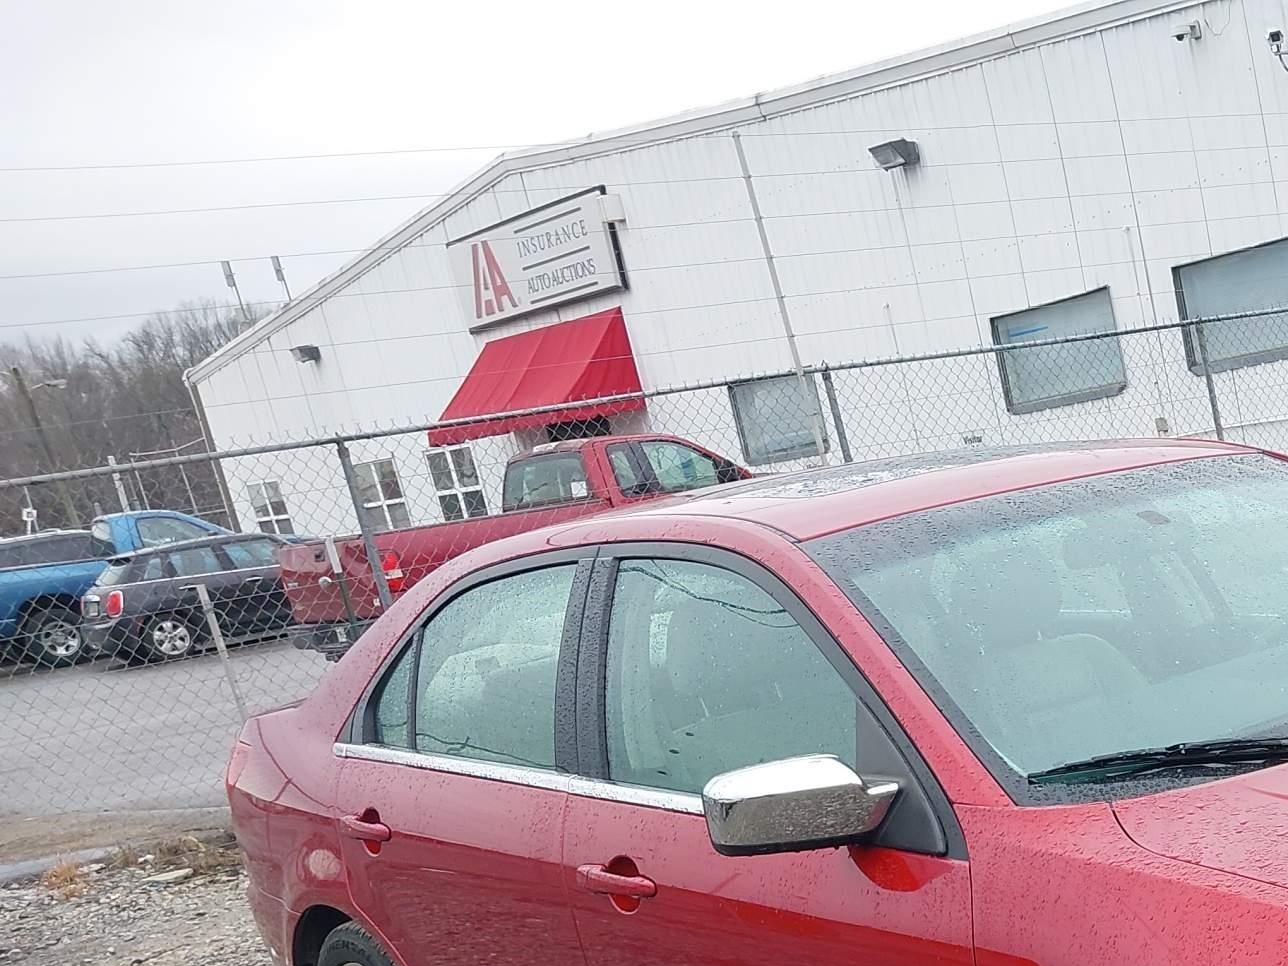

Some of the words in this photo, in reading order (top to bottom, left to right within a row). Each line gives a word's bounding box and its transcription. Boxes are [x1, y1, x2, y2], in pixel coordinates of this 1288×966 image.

[516, 219, 588, 258] INSURANCE
[527, 269, 551, 294] AUTO
[551, 258, 597, 287] AUCTIONS
